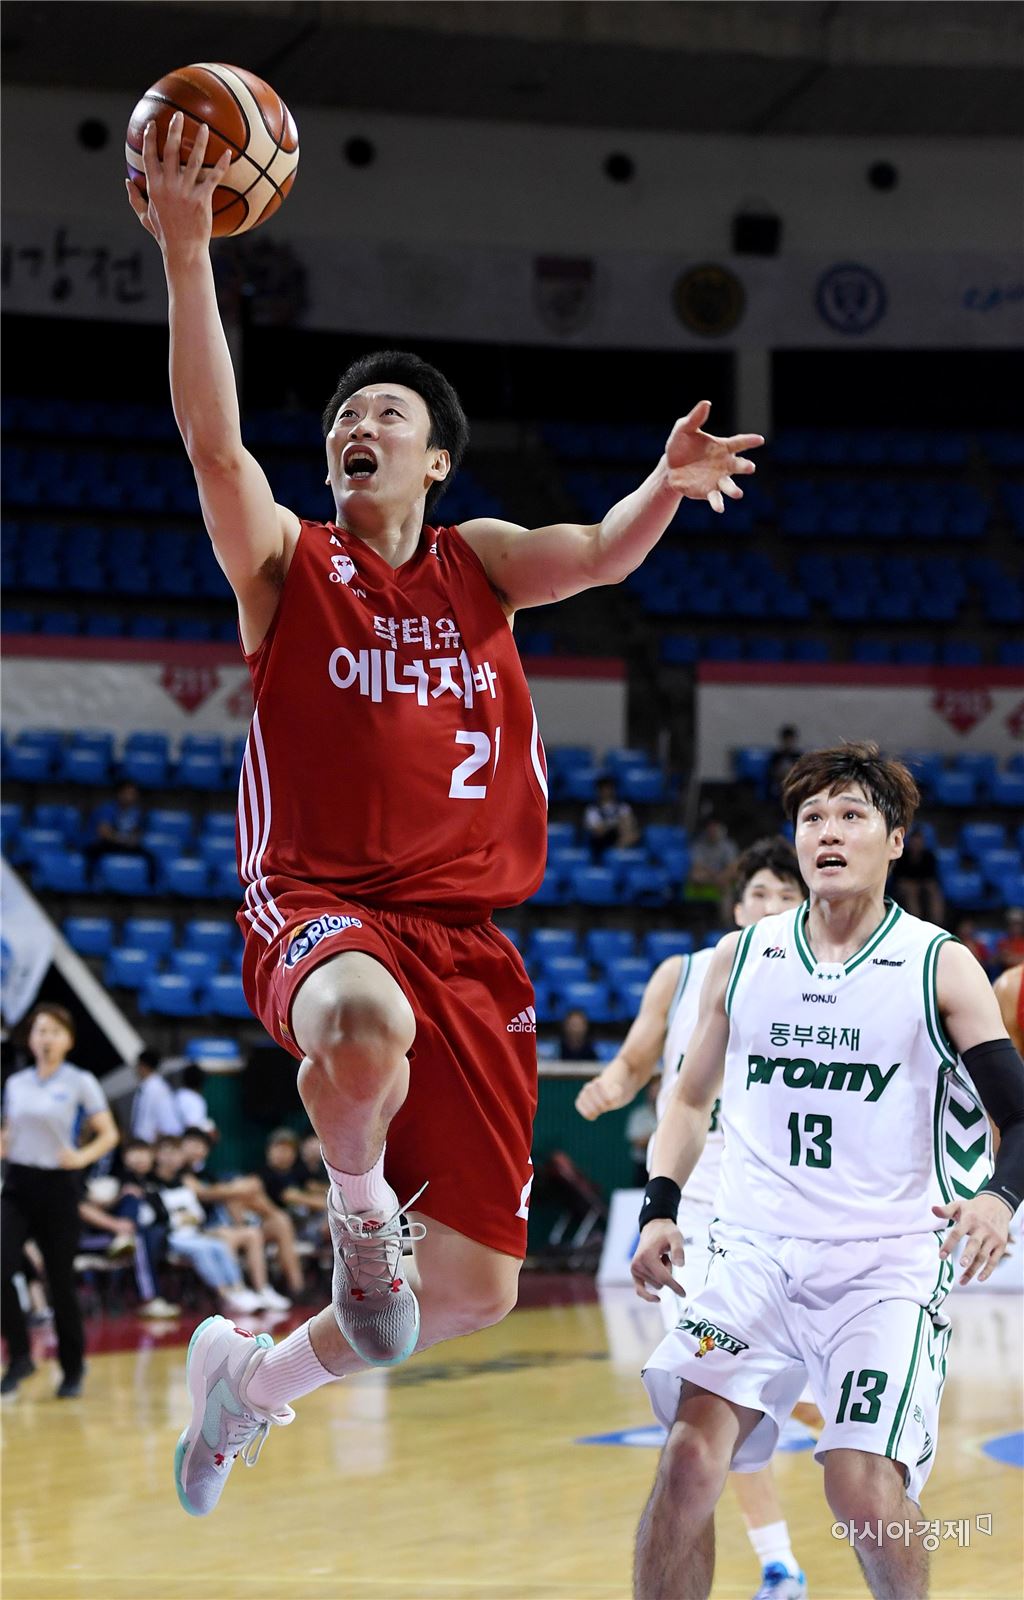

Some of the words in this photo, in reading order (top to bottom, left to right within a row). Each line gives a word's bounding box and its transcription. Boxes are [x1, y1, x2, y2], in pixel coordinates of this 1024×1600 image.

[1, 226, 147, 302] 강전
[448, 727, 501, 799] 2
[802, 993, 837, 1004] WONJU
[769, 1022, 861, 1052] 동부화재
[787, 1111, 833, 1169] 13
[835, 1368, 888, 1425] 13
